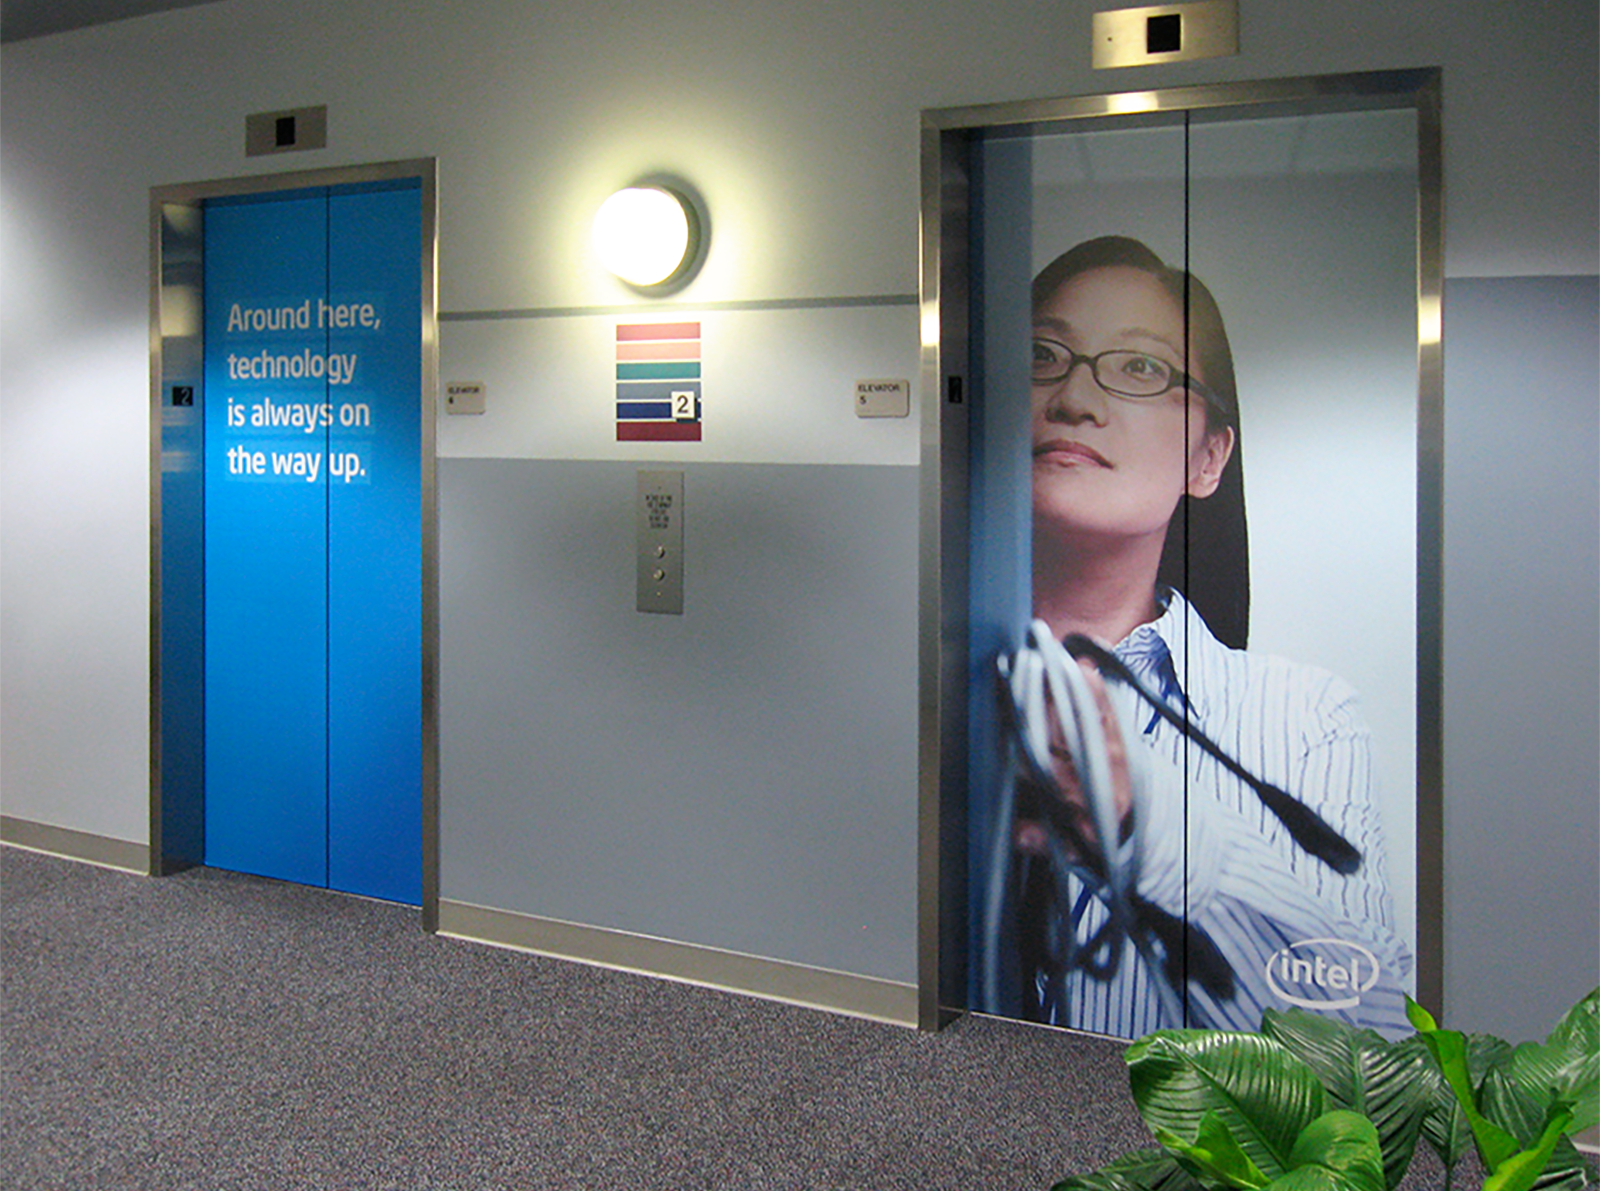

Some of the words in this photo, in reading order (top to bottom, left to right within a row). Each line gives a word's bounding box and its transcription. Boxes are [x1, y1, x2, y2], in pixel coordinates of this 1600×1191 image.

[227, 299, 310, 332] Around
[318, 299, 381, 330] here,
[227, 348, 357, 385] technology
[181, 387, 191, 406] 2
[676, 394, 689, 414] 2
[858, 383, 900, 393] ELEVATOR
[227, 397, 246, 427] is
[251, 397, 334, 433] always
[339, 403, 370, 427] on
[227, 444, 266, 475] the
[271, 452, 322, 483] way
[328, 452, 366, 483] up.
[1281, 948, 1359, 992] intel
